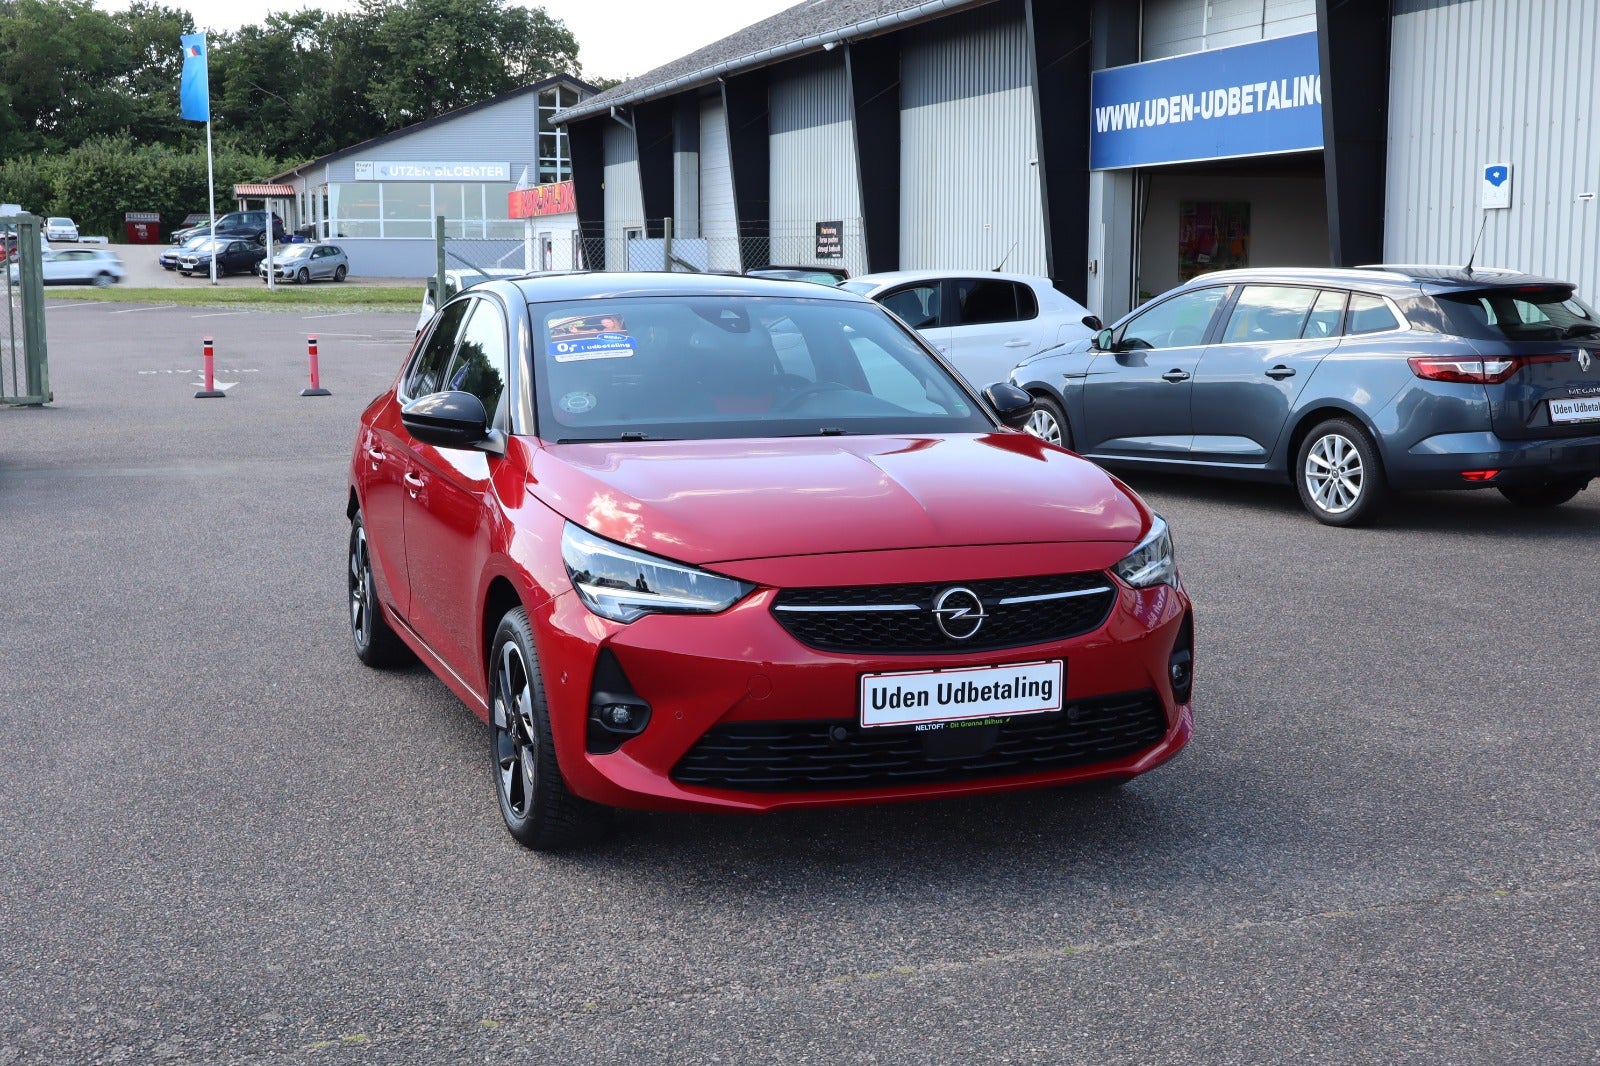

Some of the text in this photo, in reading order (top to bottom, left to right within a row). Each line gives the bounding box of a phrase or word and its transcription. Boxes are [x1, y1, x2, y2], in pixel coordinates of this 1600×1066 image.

[435, 166, 504, 177] BILCENTER
[1553, 404, 1573, 414] Uden
[872, 676, 1053, 710] Uden Udbetaling
[915, 722, 945, 732] NELTOFT
[985, 718, 1003, 726] Bilhus
